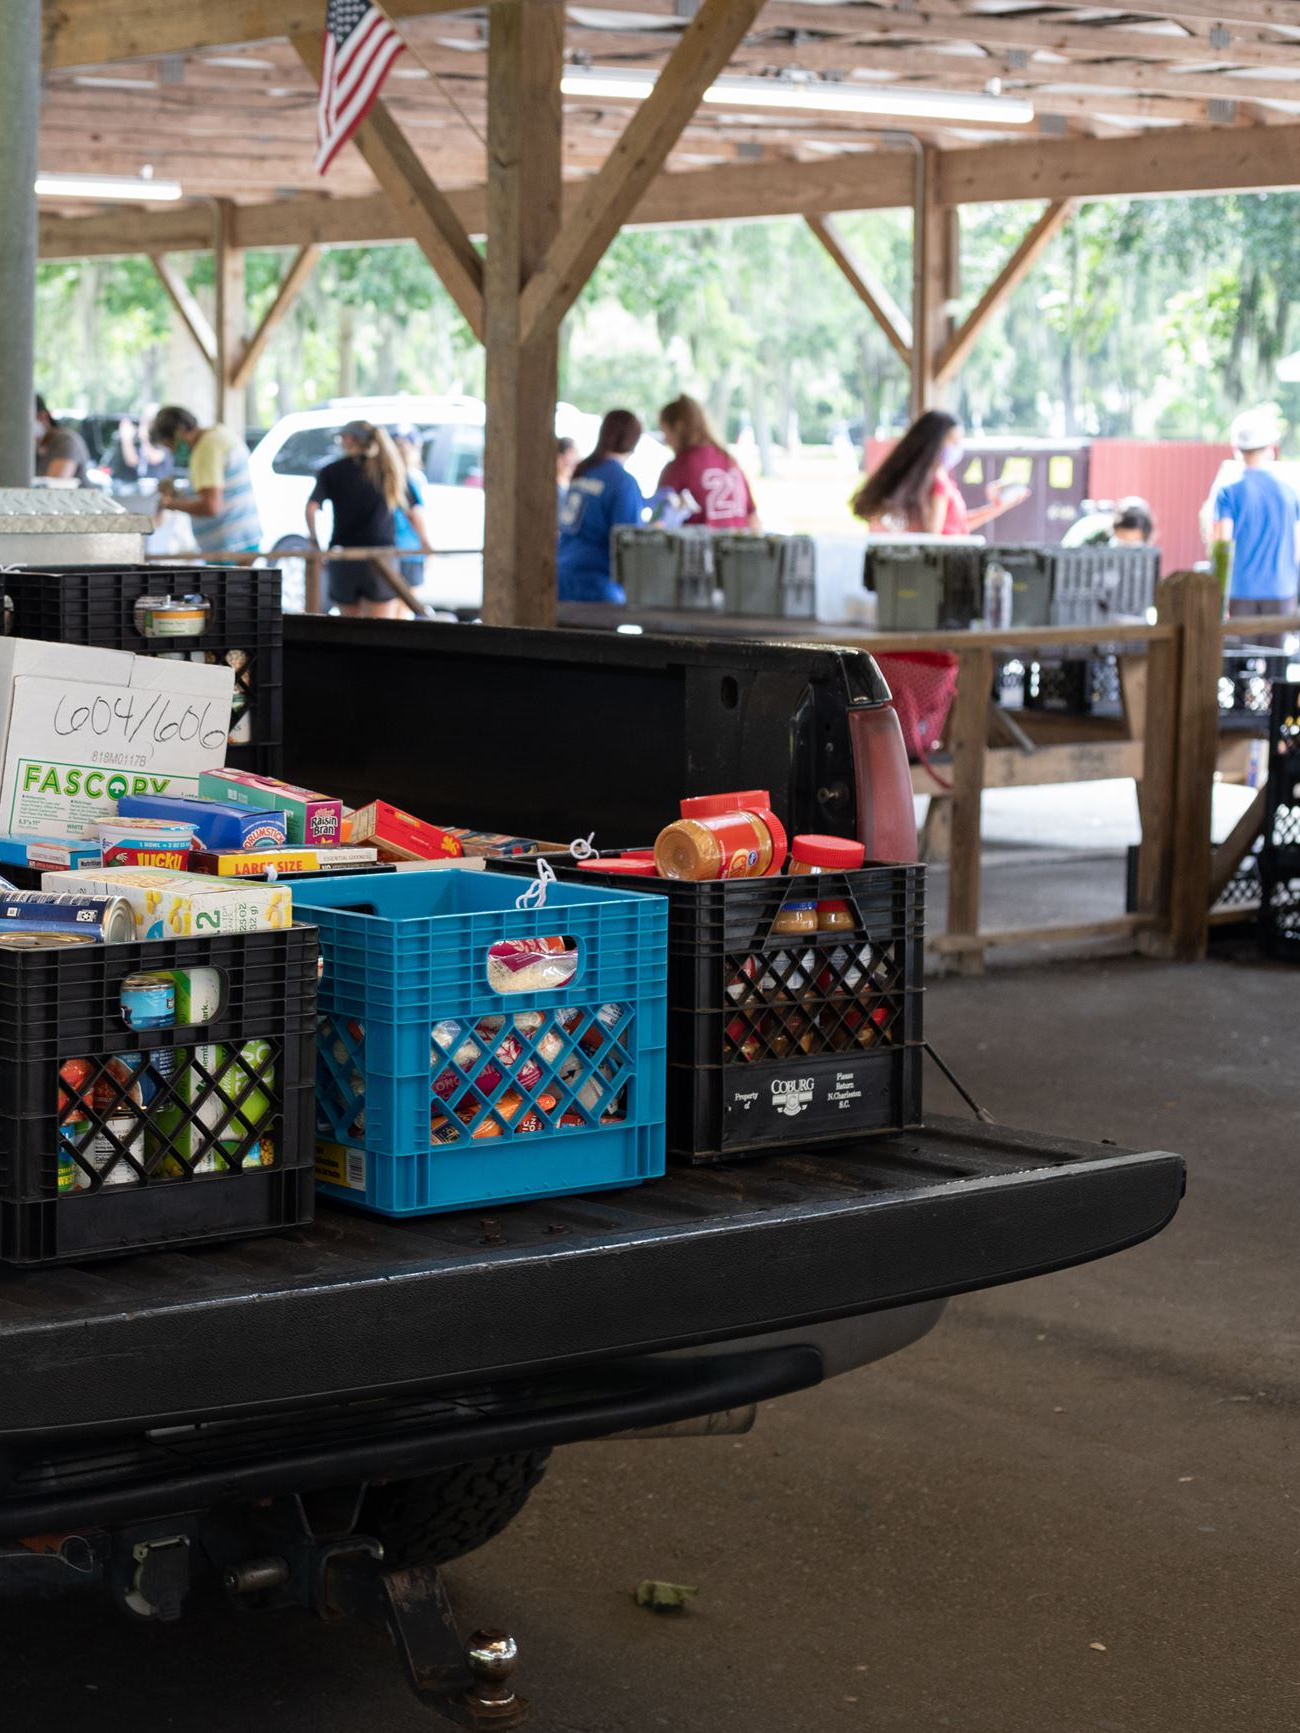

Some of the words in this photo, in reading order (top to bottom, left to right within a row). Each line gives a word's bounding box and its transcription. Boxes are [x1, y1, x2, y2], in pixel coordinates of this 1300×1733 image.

[53, 693, 226, 750] 604/606
[22, 763, 171, 801] FASCOPY
[311, 817, 338, 828] Raisin
[313, 825, 335, 836] Bran
[279, 860, 303, 872] SIZE
[195, 910, 221, 934] 2
[770, 1077, 815, 1095] COBURG
[734, 1091, 759, 1102] Property
